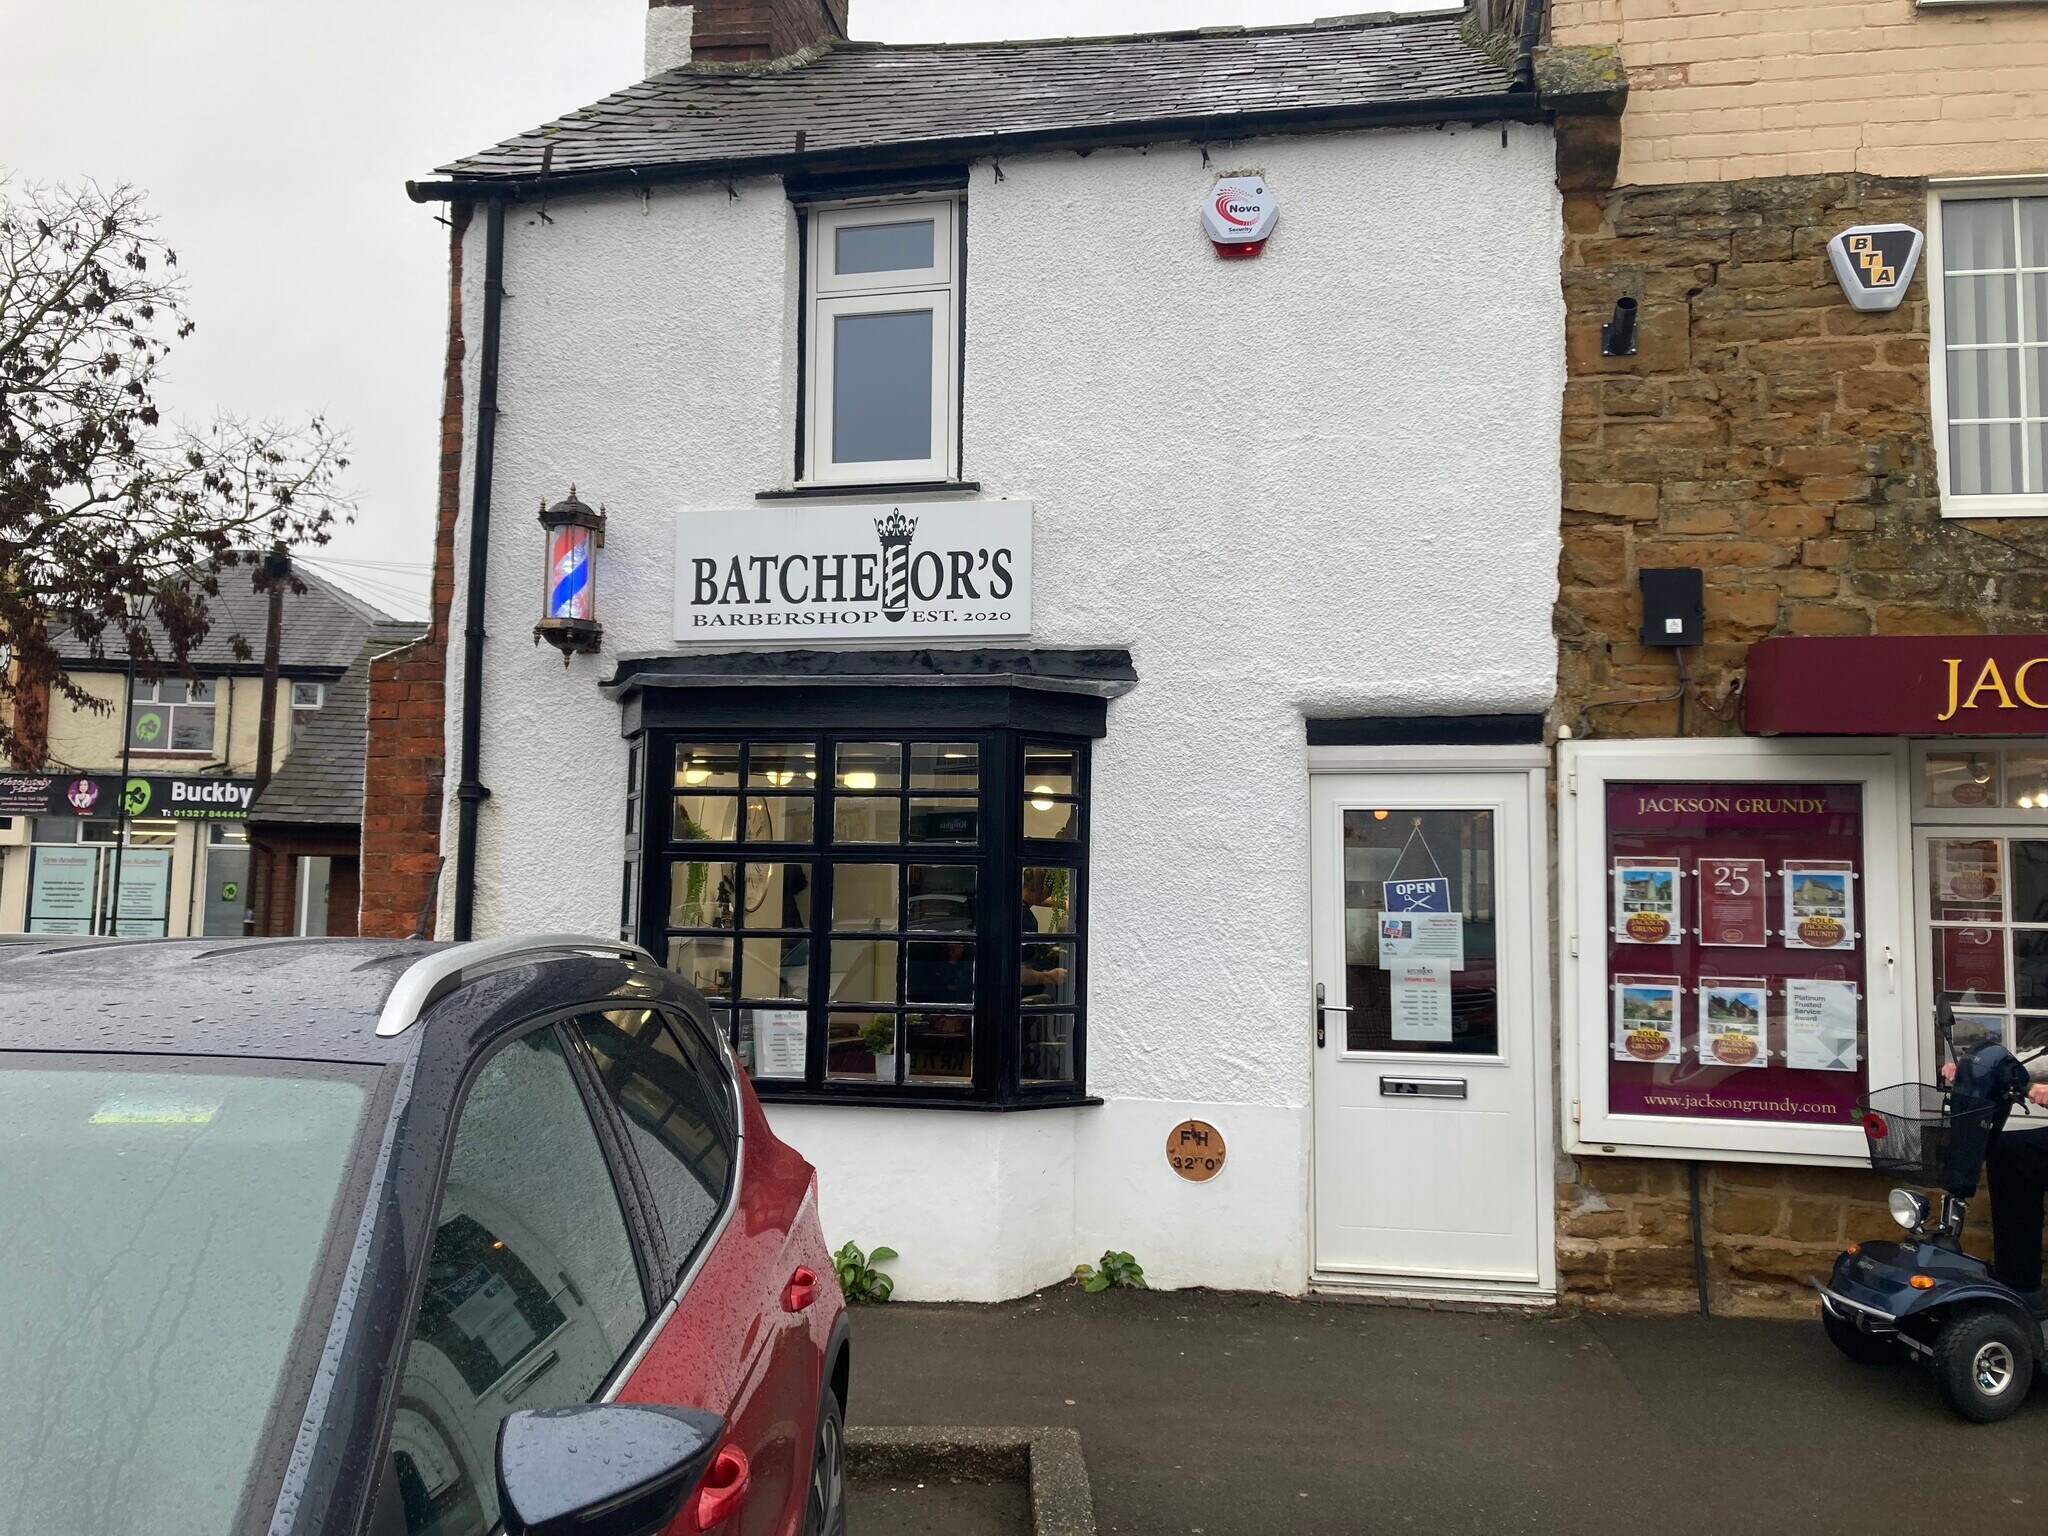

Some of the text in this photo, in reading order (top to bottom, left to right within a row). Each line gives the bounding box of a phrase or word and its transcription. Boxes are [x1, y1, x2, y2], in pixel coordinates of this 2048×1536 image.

[1229, 204, 1261, 213] Nova
[1228, 226, 1253, 234] Security
[692, 609, 1012, 627] BARBERSHOP EST. 2020
[171, 781, 254, 808] Buckby
[1638, 798, 1827, 815] JACKSON GRUNDY
[161, 809, 248, 818] T: 01327 844444
[1714, 866, 1750, 896] 25
[1395, 882, 1436, 895] OPEN
[1804, 930, 1839, 938] GRUNDY
[1794, 994, 1826, 1002] Platinum
[1643, 1094, 1837, 1116] www.jacksongrundy.com
